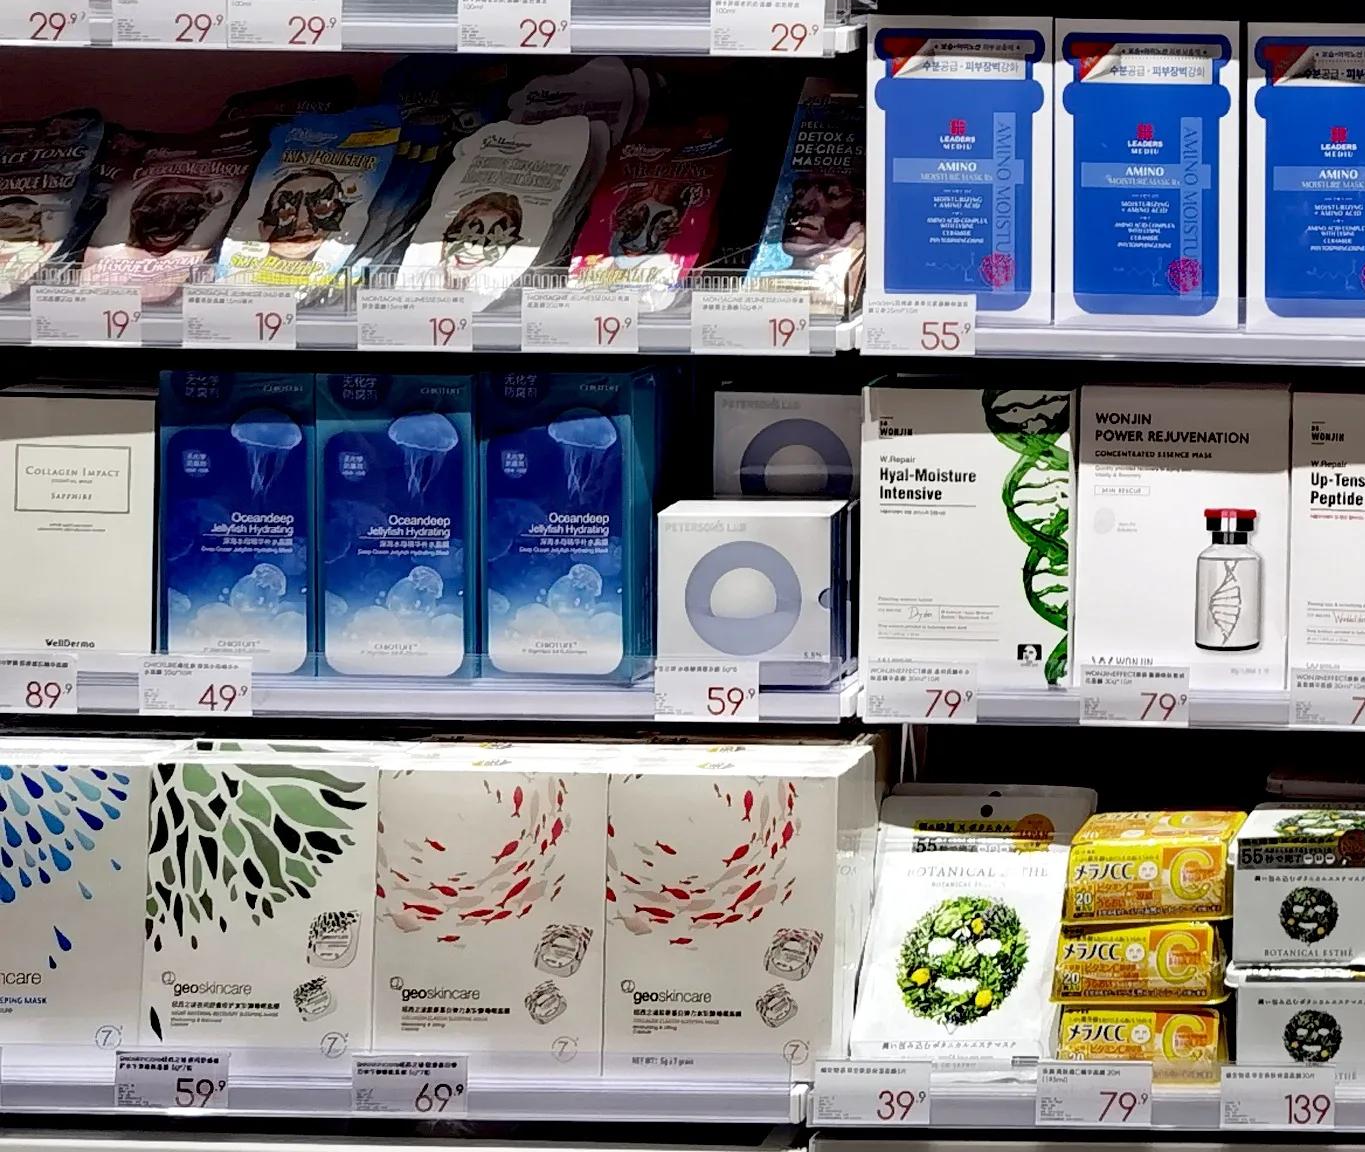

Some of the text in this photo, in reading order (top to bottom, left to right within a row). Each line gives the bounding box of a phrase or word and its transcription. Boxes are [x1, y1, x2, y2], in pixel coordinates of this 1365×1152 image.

[923, 60, 1019, 73] 수분공급 피부장벽강화
[1320, 143, 1357, 152] LEADERS
[1319, 169, 1358, 179] AMINO
[1096, 429, 1249, 445] POWER REJUVENATION
[26, 466, 120, 477] COLLAGEN IMPACT
[879, 468, 976, 484] Hyal-Moisture
[879, 486, 942, 500] Intensive
[1311, 490, 1365, 509] Peptide
[232, 512, 294, 524] Oceandeep
[388, 514, 450, 529] Oceandeep
[528, 523, 610, 536] Jellyfish Hydrating
[45, 638, 95, 648] WellDerma
[1074, 862, 1132, 881] メラノCC
[1075, 892, 1092, 906] 20
[173, 981, 252, 997] geoskincare
[1284, 1095, 1331, 1124] 139
